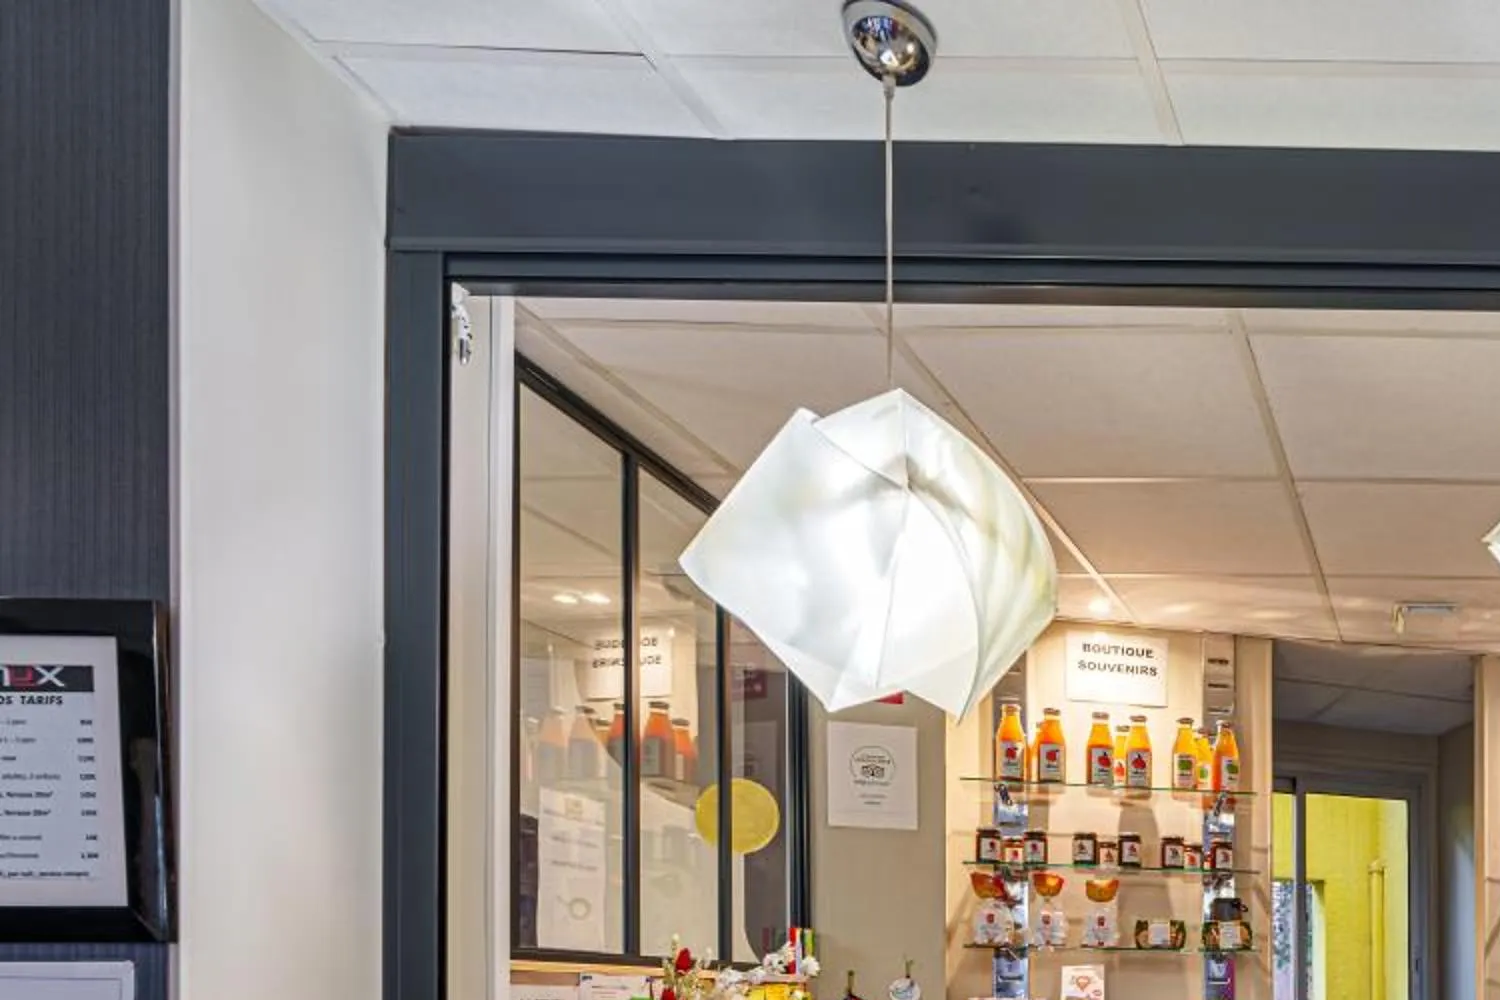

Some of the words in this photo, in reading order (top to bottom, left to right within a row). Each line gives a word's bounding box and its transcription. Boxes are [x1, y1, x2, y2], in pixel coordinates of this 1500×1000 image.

[1082, 643, 1155, 659] BOUTIQUE
[1077, 659, 1159, 677] SOUVENIRS
[20, 695, 64, 706] TARIFS
